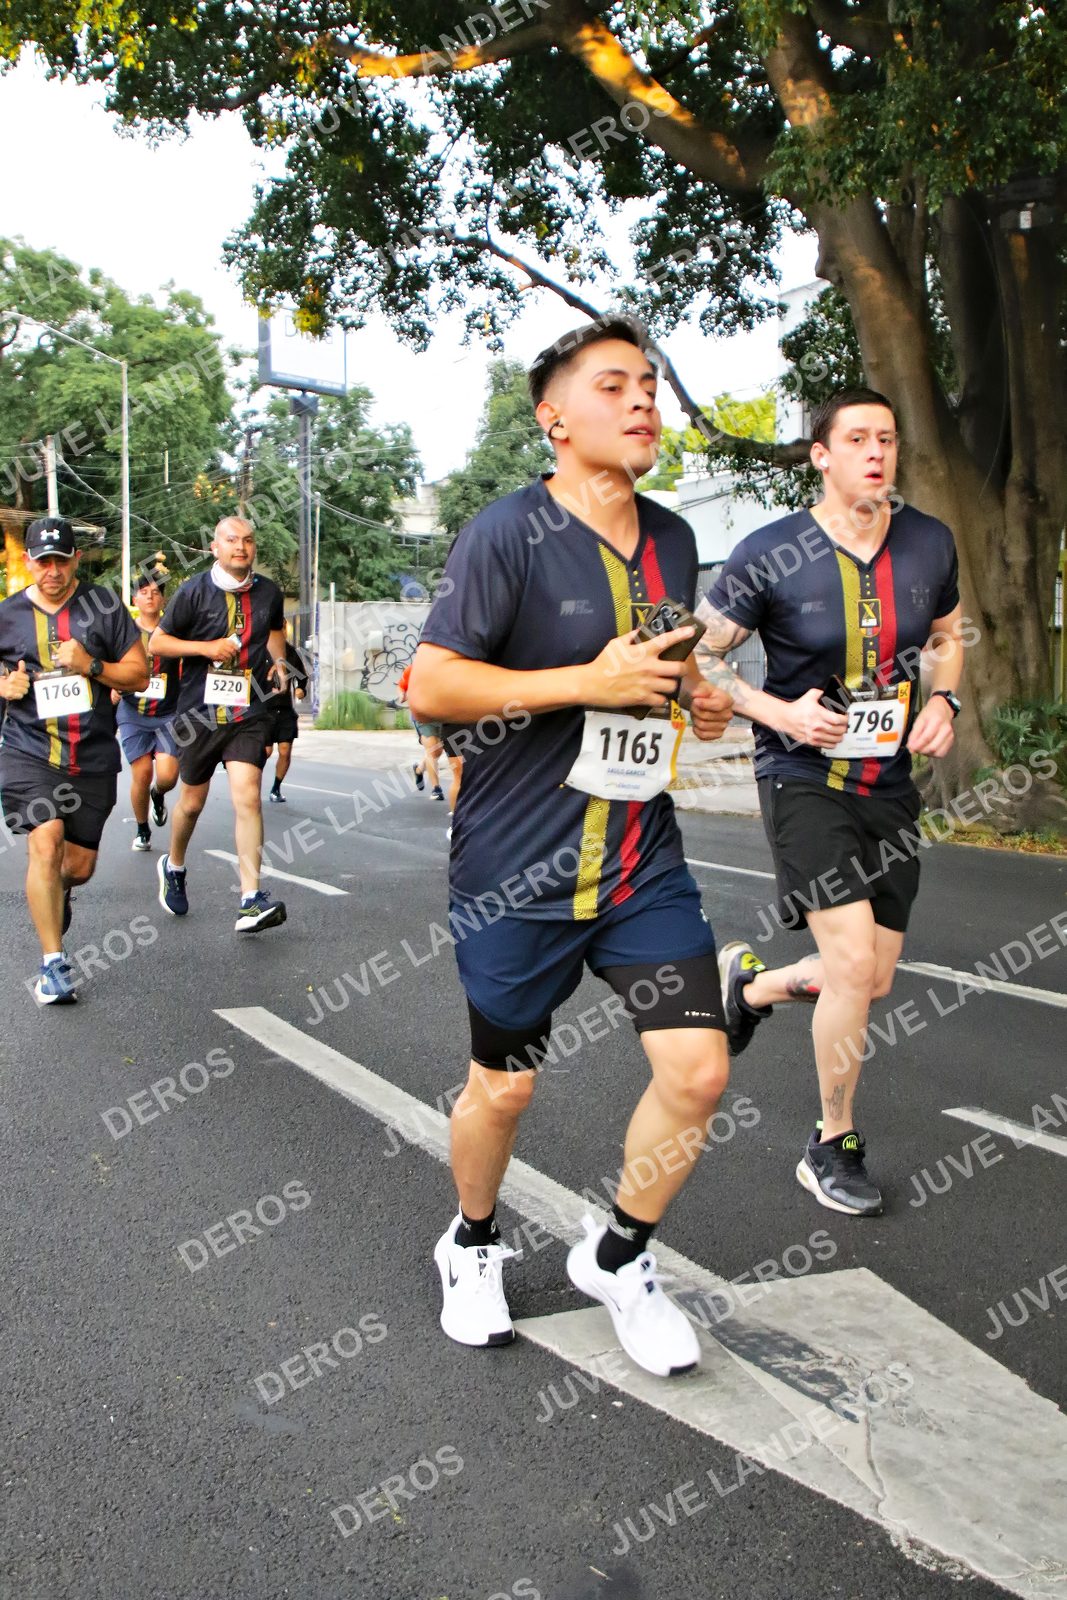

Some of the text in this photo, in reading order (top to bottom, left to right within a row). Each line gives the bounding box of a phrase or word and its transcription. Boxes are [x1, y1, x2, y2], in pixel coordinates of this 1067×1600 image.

[42, 681, 81, 701] 1766
[212, 679, 243, 693] 5220
[847, 709, 894, 734] 796
[599, 727, 663, 765] 1165
